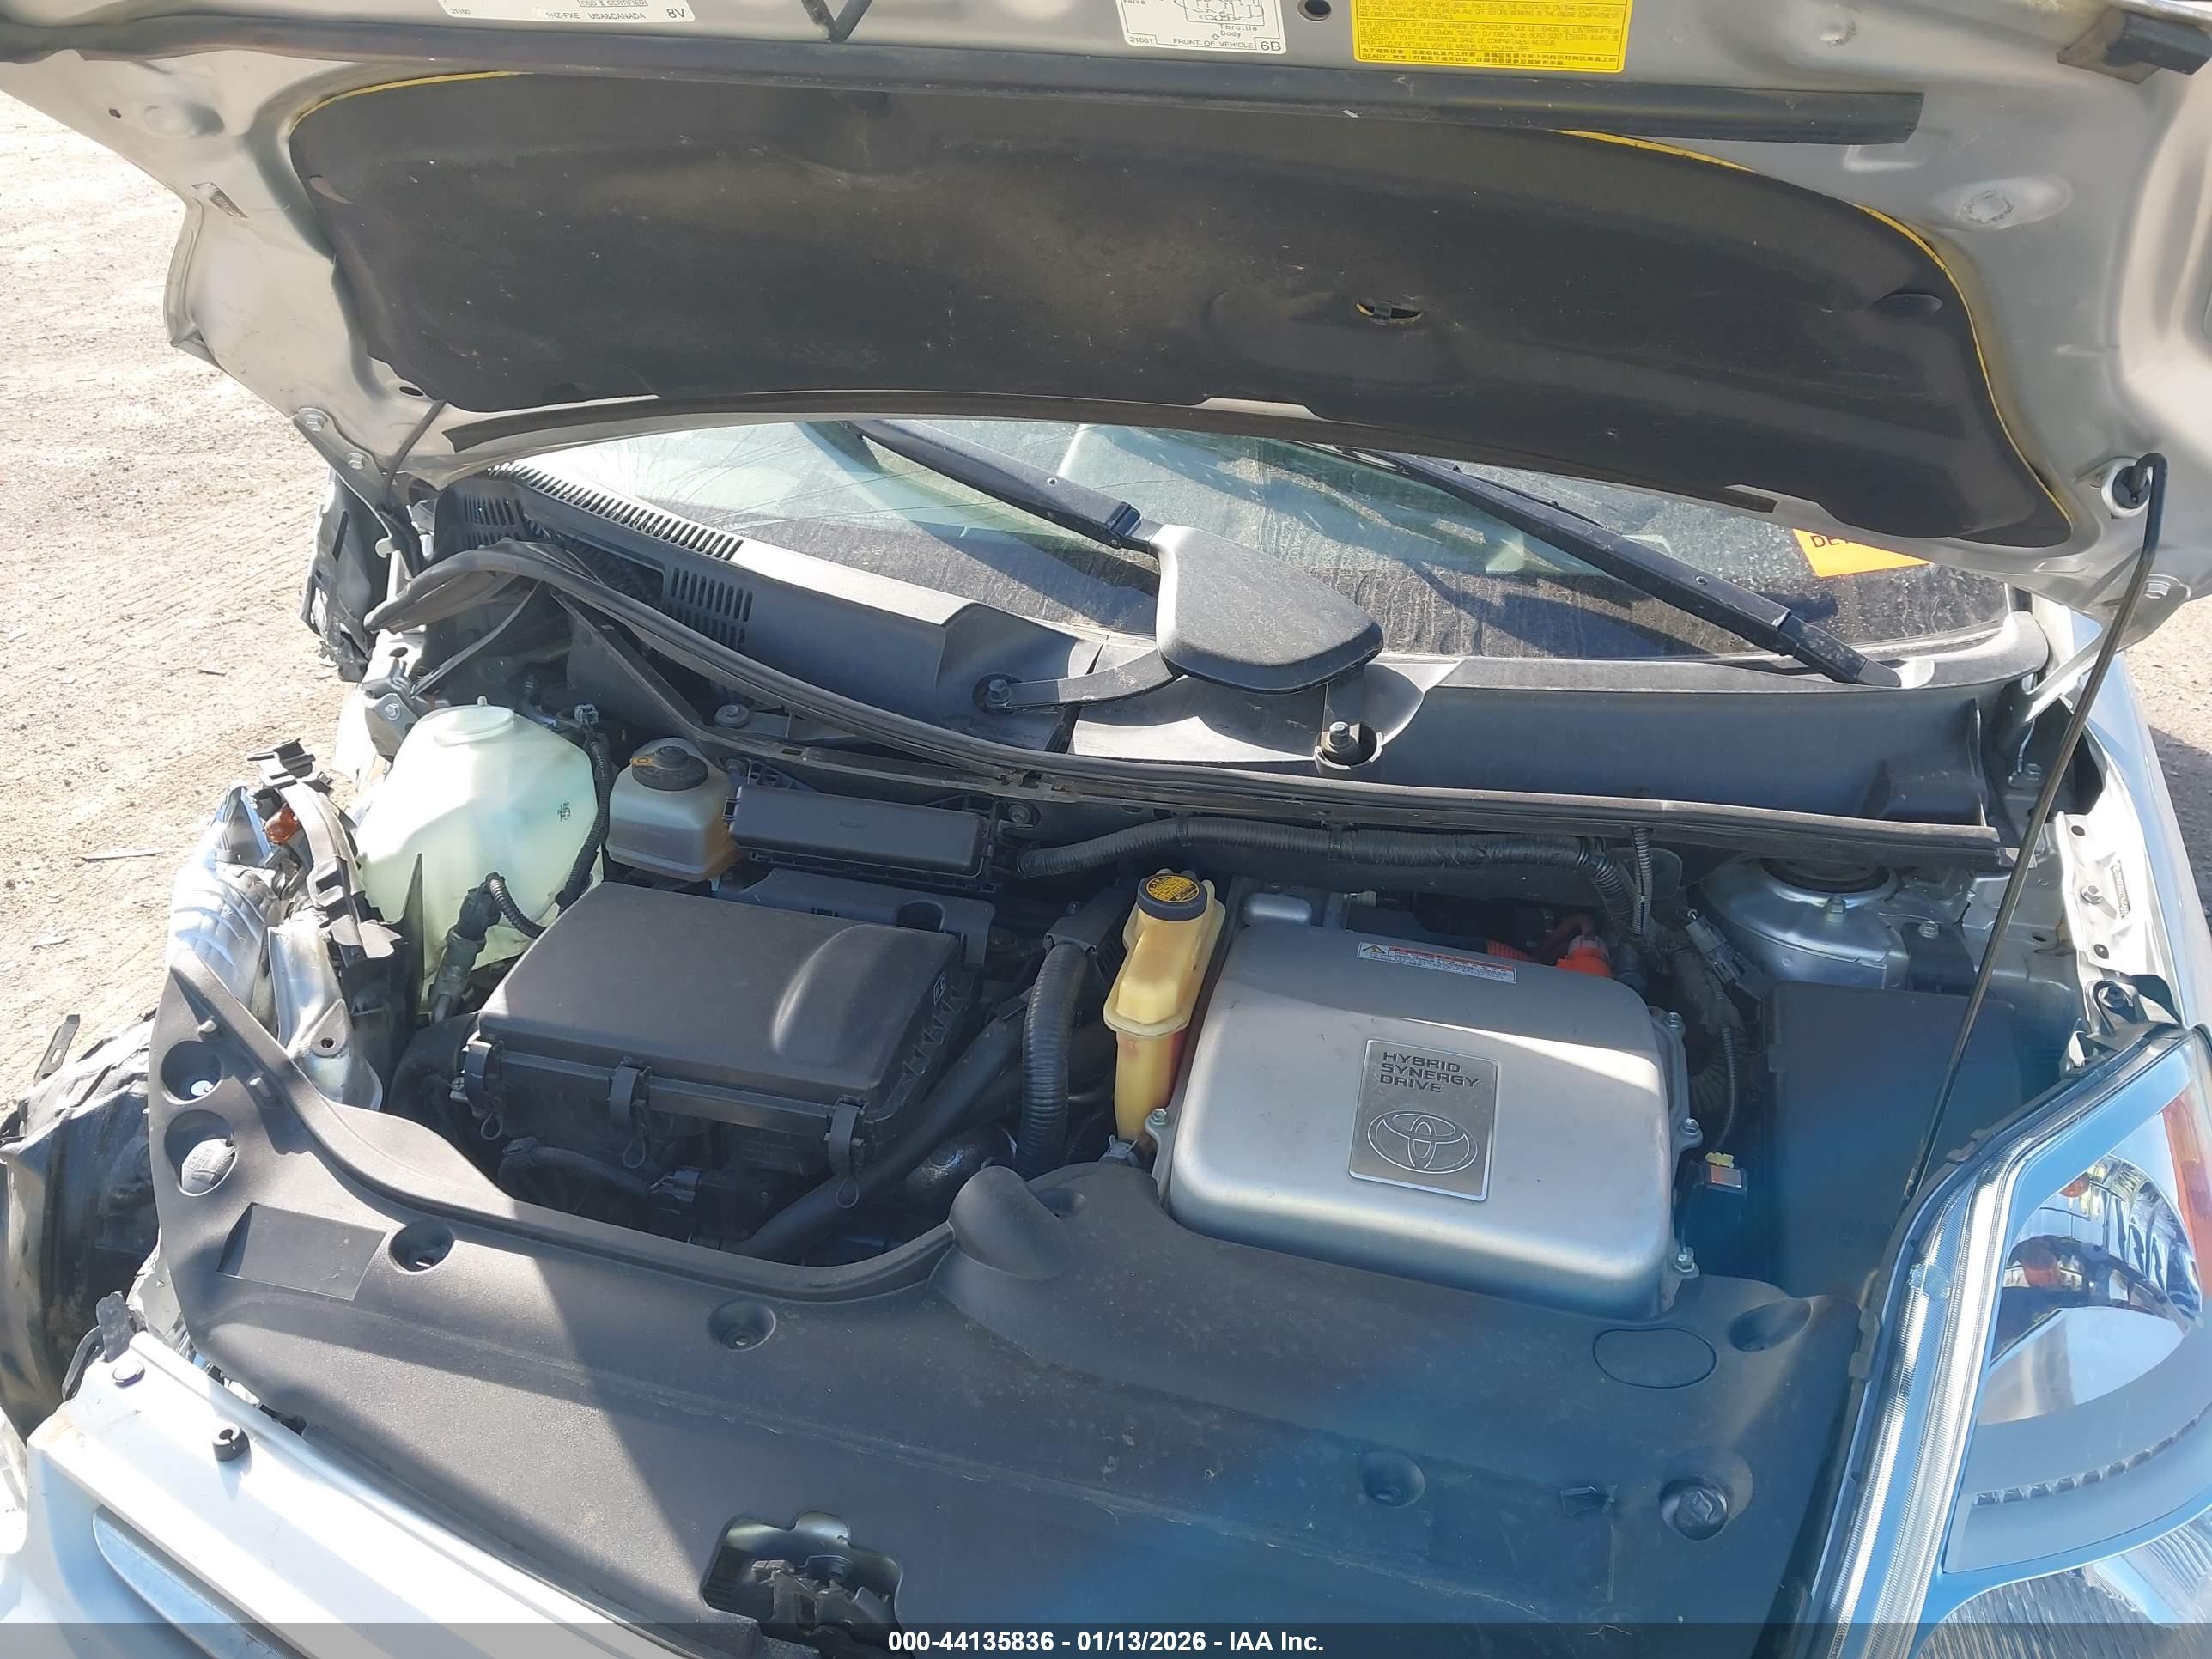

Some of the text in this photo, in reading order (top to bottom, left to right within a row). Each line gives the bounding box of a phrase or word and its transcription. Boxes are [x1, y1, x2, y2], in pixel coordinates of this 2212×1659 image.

[666, 8, 685, 19] 8V
[1220, 23, 1258, 32] Throttle
[1261, 41, 1281, 51] 6B
[1810, 535, 1850, 548] DE
[1383, 1052, 1461, 1073] HYBRID
[1381, 1063, 1480, 1087] SYNERGY
[1379, 1074, 1443, 1093] DRIVE
